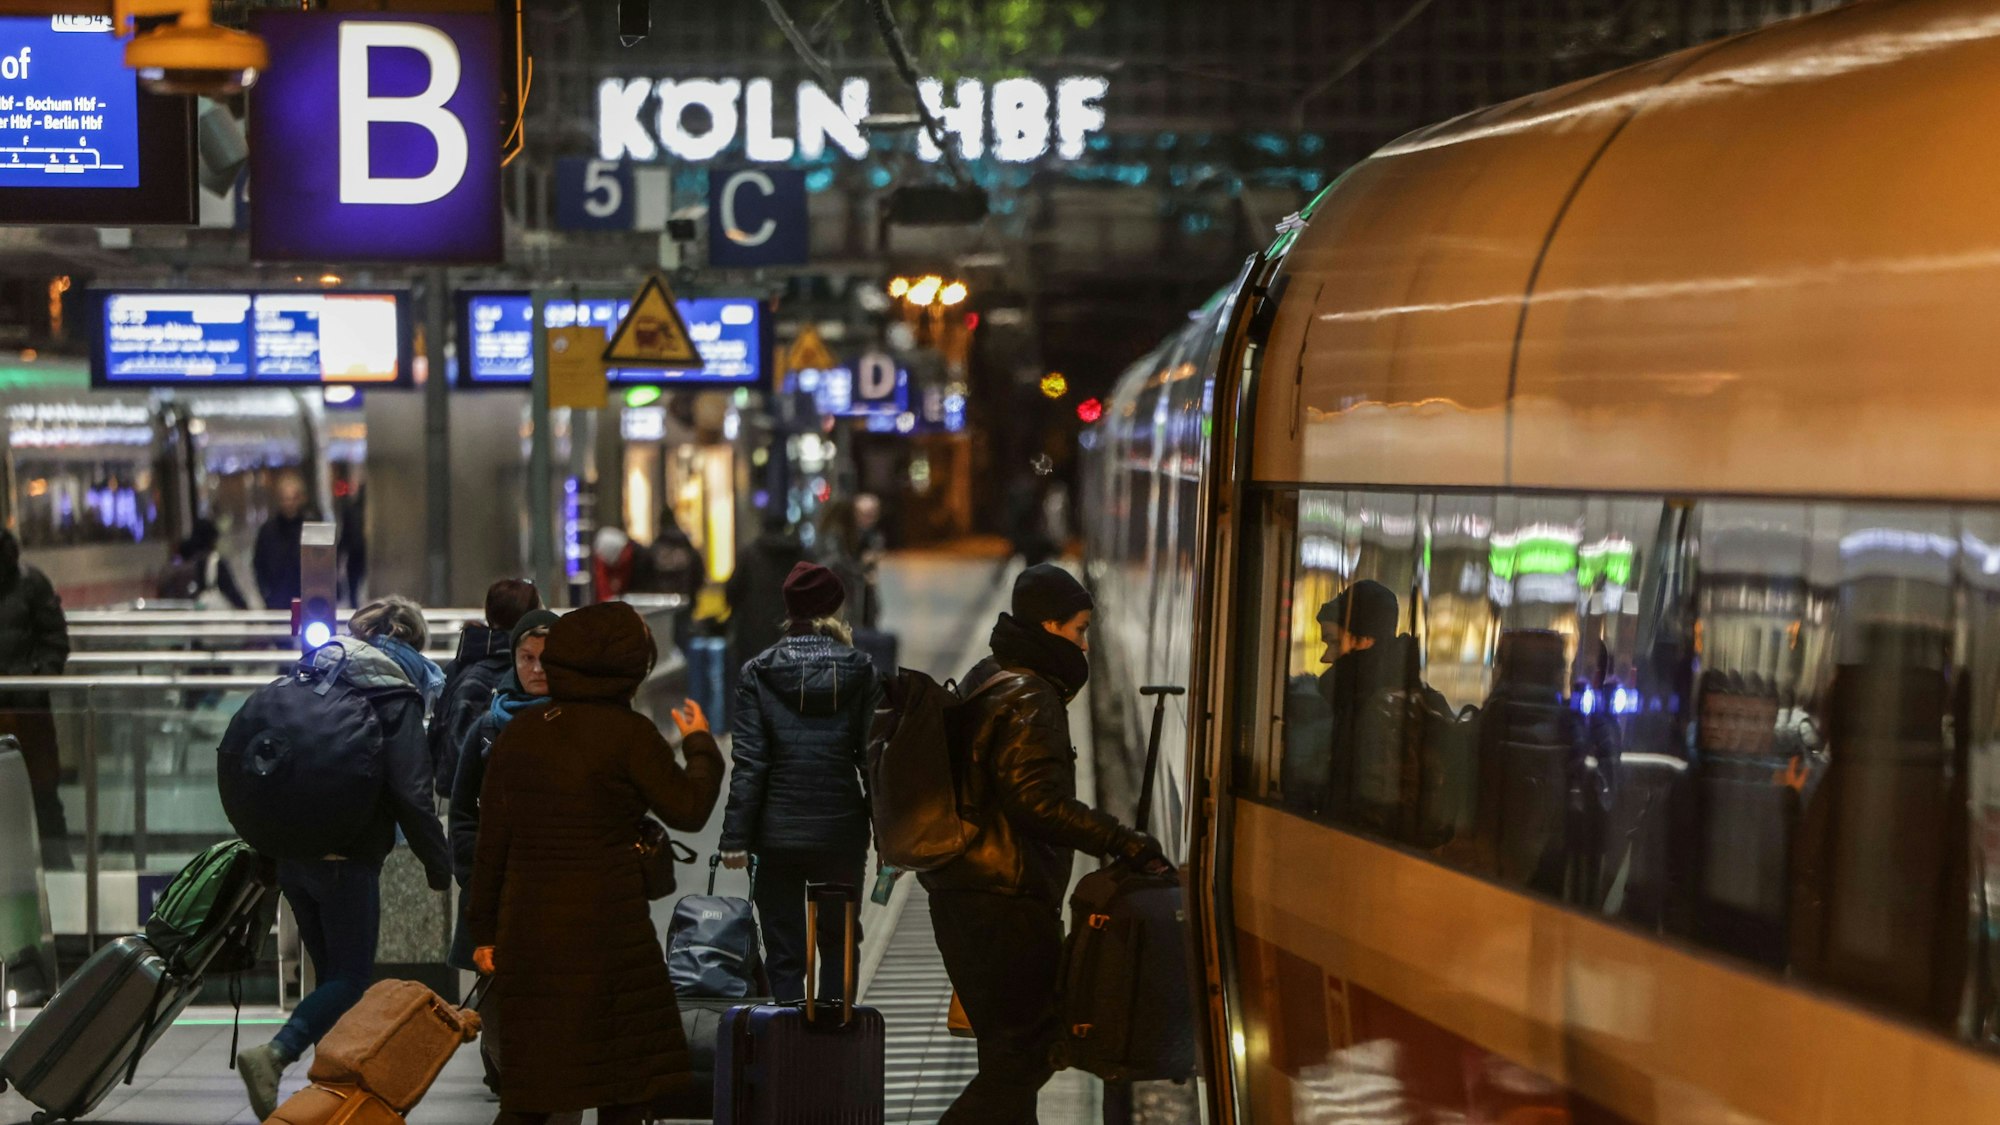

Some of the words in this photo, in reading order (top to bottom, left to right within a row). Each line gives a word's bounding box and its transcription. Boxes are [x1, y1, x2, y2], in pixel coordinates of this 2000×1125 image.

[10, 113, 32, 129] Hbf
[44, 114, 79, 130] Berlin
[81, 114, 103, 130] Hbf
[25, 95, 73, 111] Bochum
[73, 96, 97, 111] Hbf
[338, 20, 468, 205] B
[598, 77, 870, 161] KÖLN
[916, 77, 1110, 163] HBF
[583, 160, 623, 217] 5
[720, 170, 777, 247] C
[859, 352, 895, 399] D
